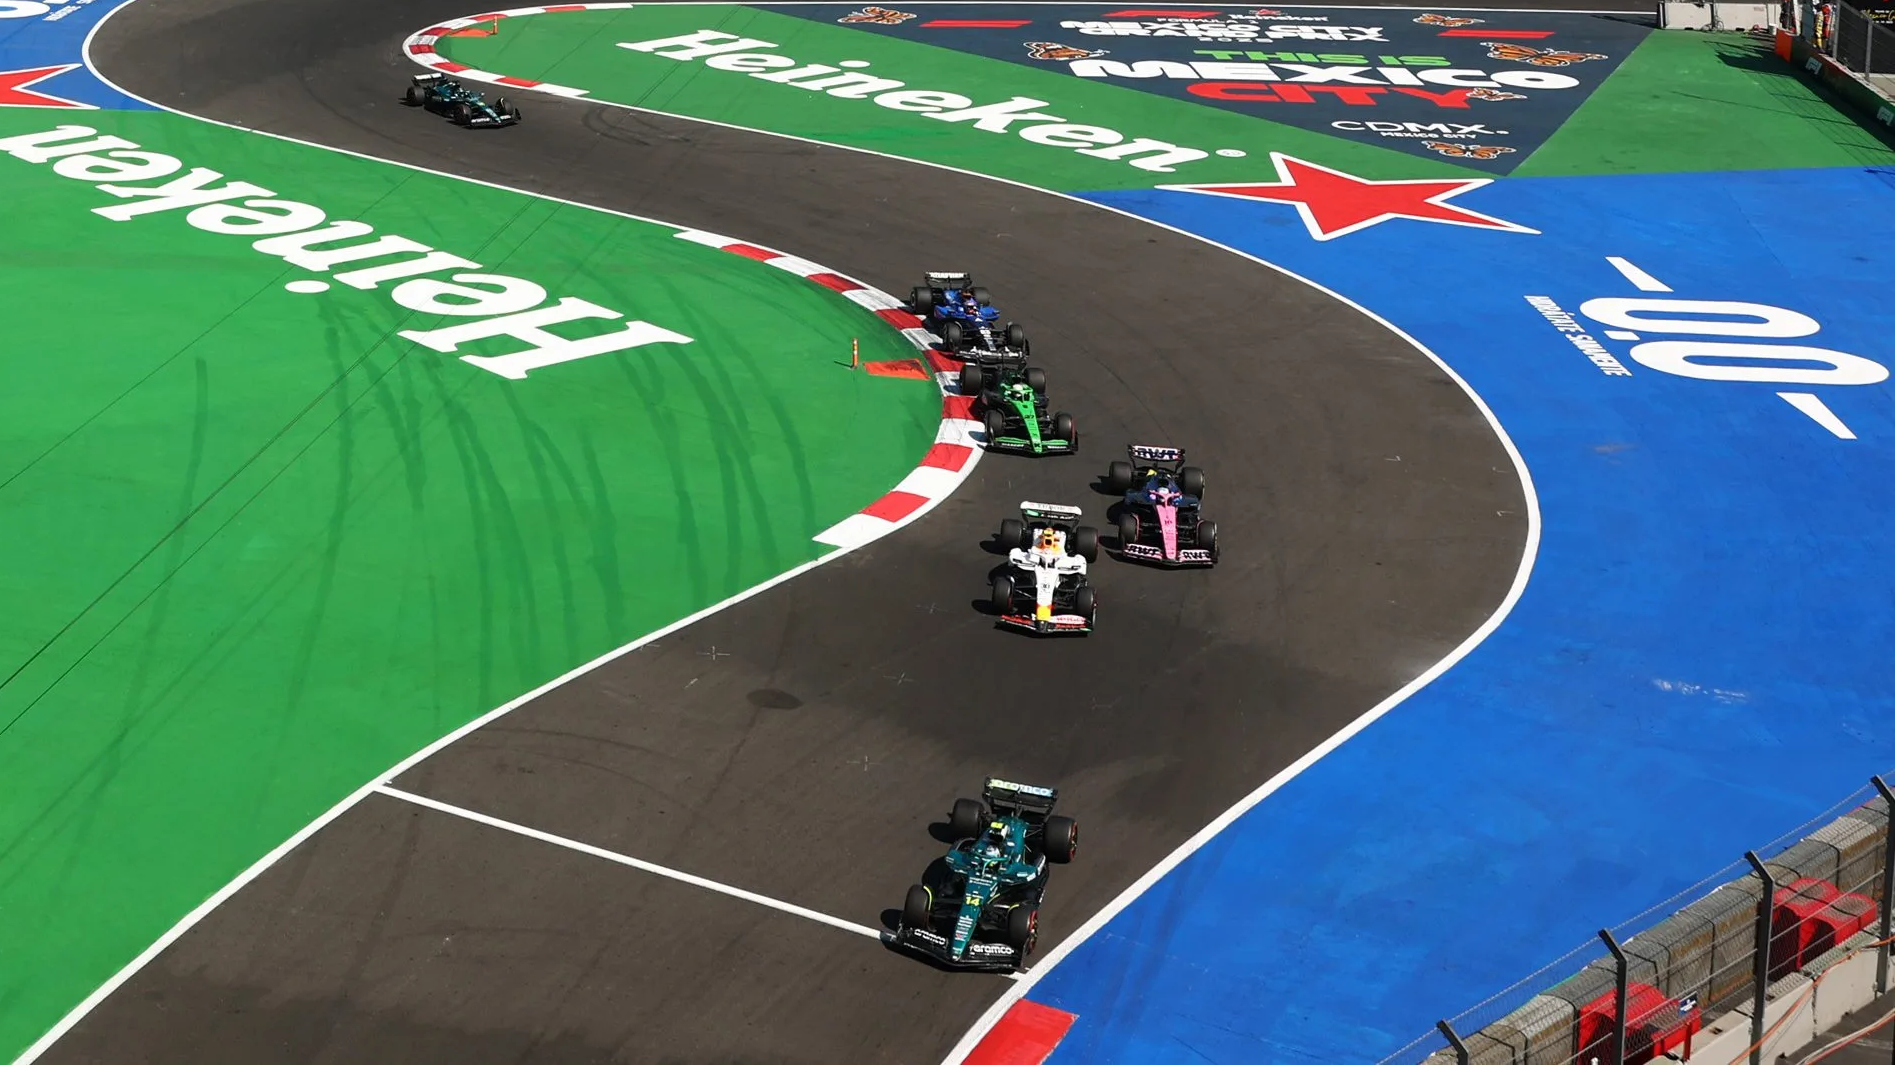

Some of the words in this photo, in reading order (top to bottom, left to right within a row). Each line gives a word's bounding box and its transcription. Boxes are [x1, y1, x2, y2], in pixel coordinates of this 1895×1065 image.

[1229, 14, 1328, 22] Heineken
[1059, 20, 1261, 32] MEXICO
[1268, 24, 1385, 36] CITY
[1079, 28, 1259, 39] GRAND
[1266, 31, 1390, 42] PRIX
[1194, 50, 1369, 65] THIS
[1378, 55, 1451, 66] IS
[1068, 59, 1580, 89] MEXICO
[615, 28, 1208, 173] Heineken
[1186, 82, 1476, 109] CITY
[965, 896, 980, 907] 14
[914, 927, 946, 945] aramco
[973, 944, 1015, 955] aramco
